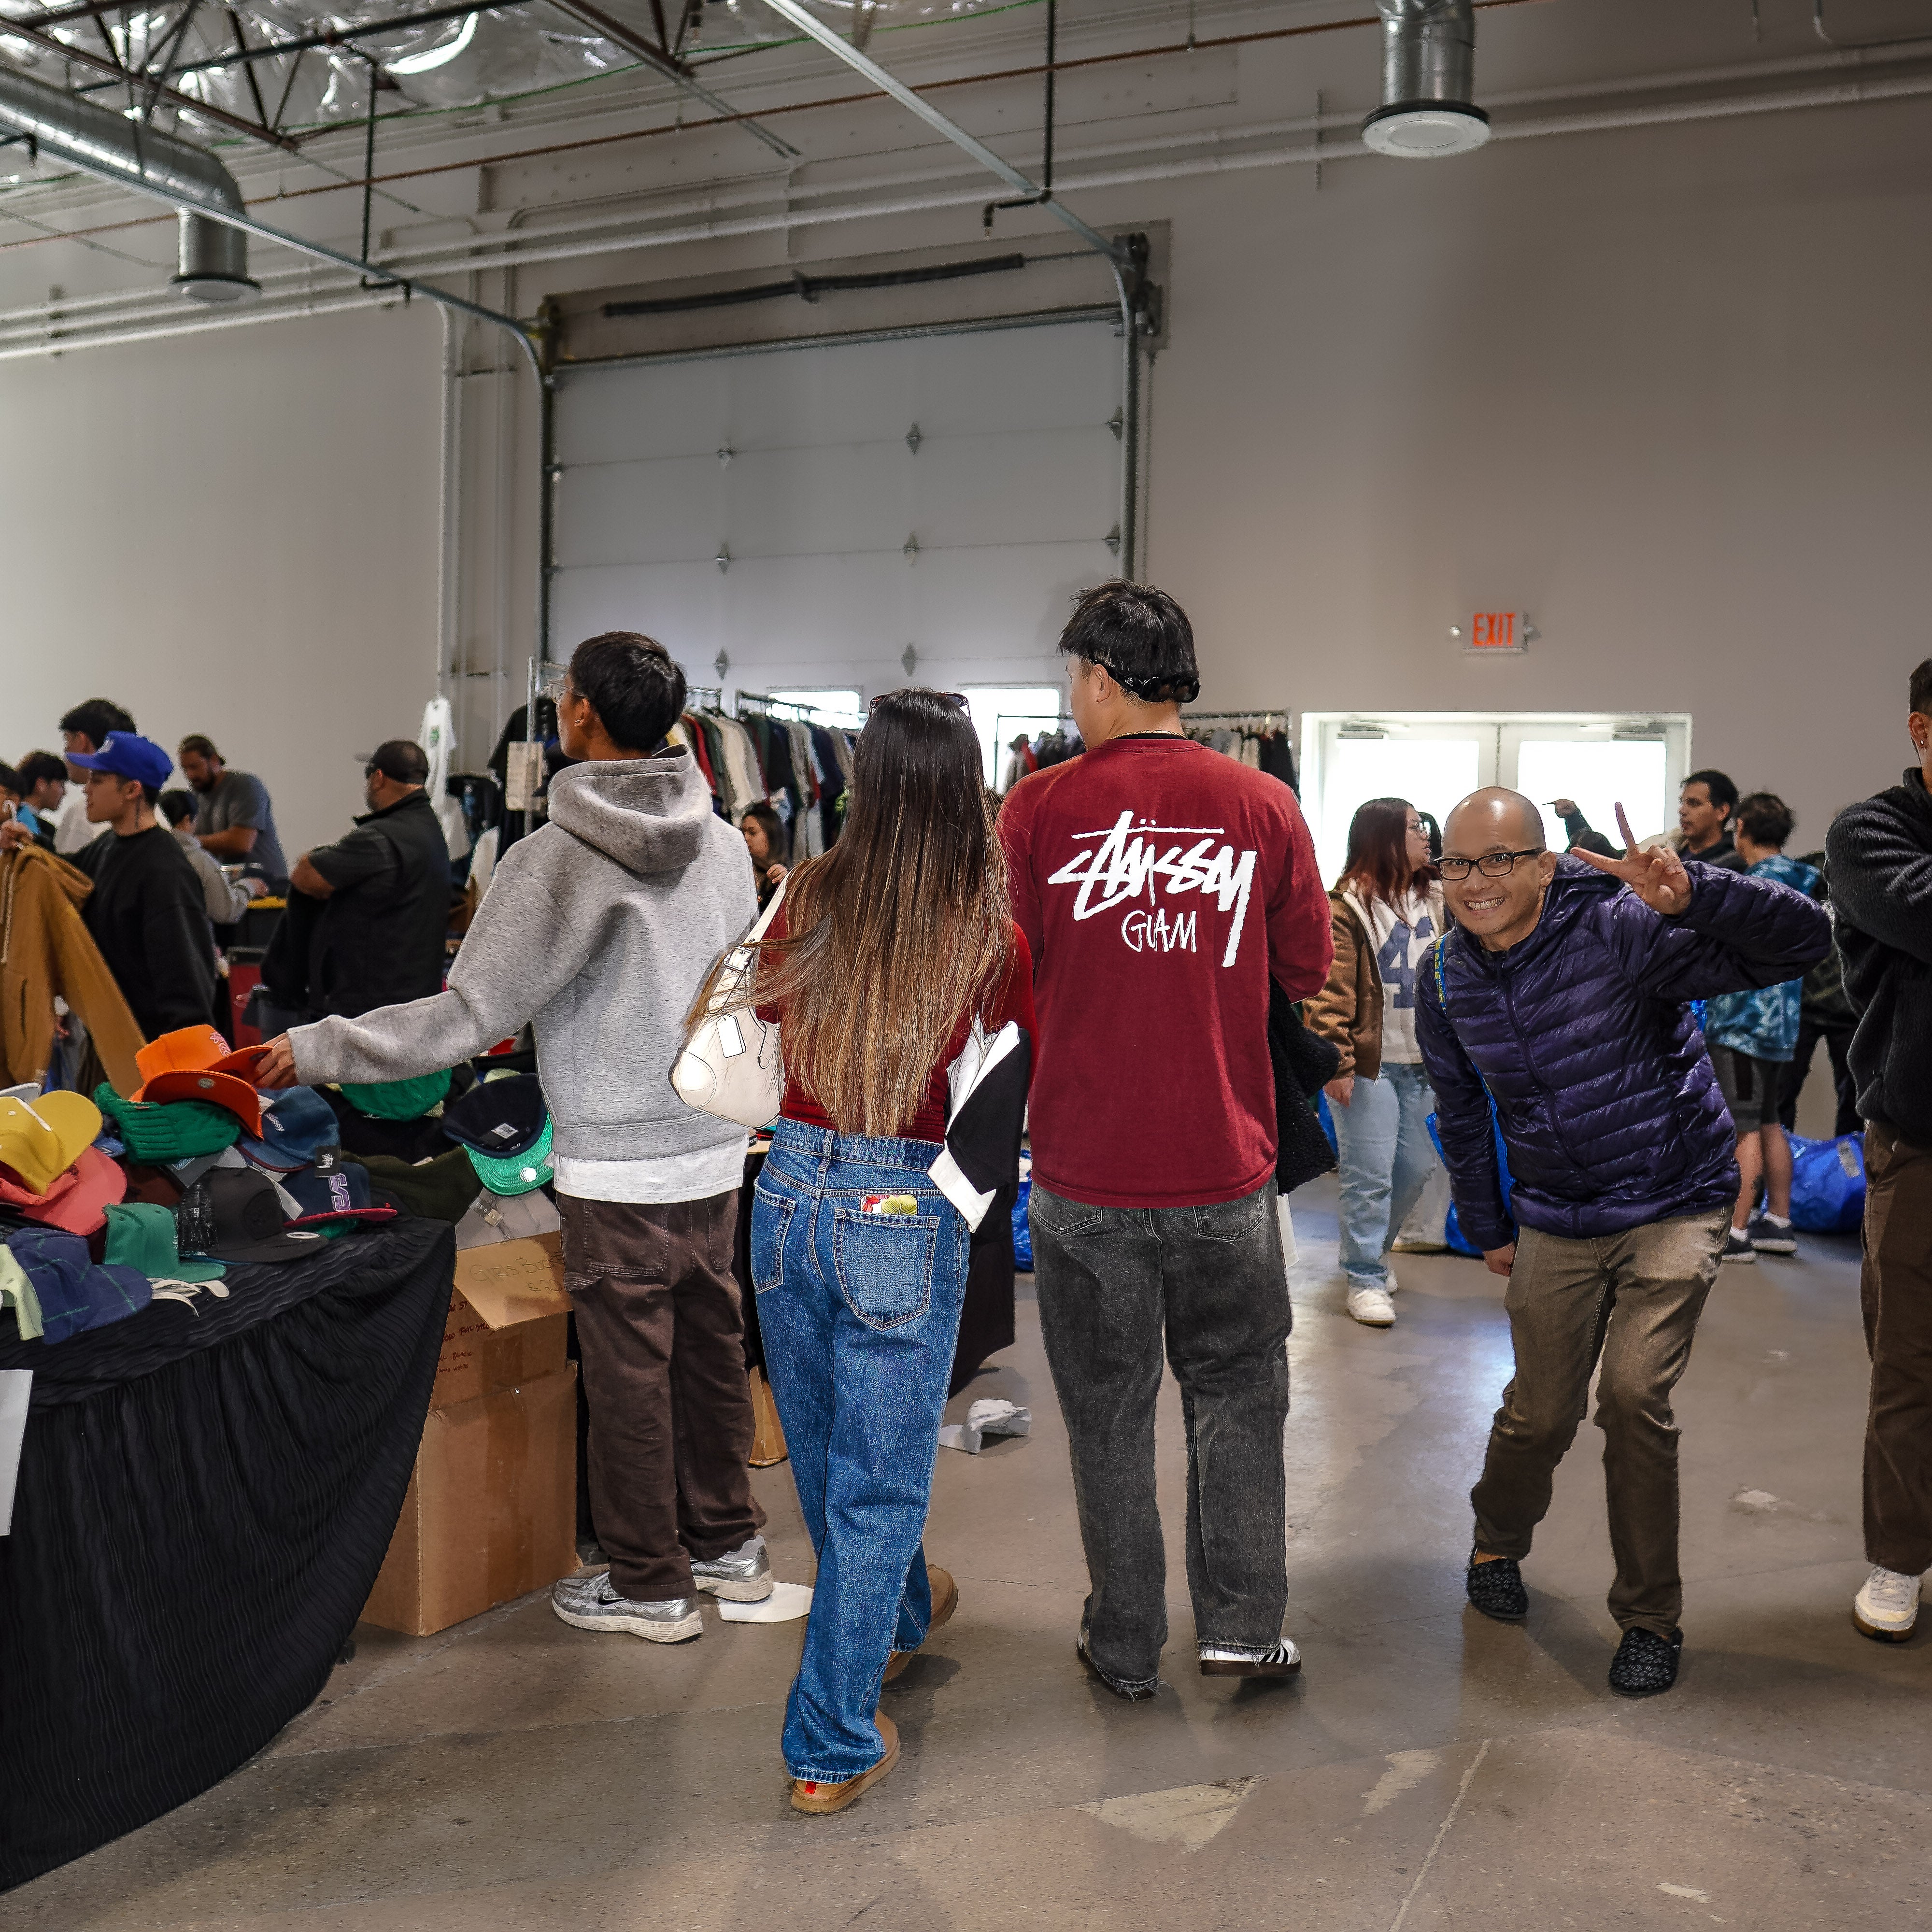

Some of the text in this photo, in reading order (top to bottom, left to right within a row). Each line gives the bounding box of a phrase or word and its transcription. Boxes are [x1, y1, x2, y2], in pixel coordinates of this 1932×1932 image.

[1473, 612, 1516, 646] EXIT
[1121, 908, 1197, 953] GUAM
[329, 1173, 351, 1212] S
